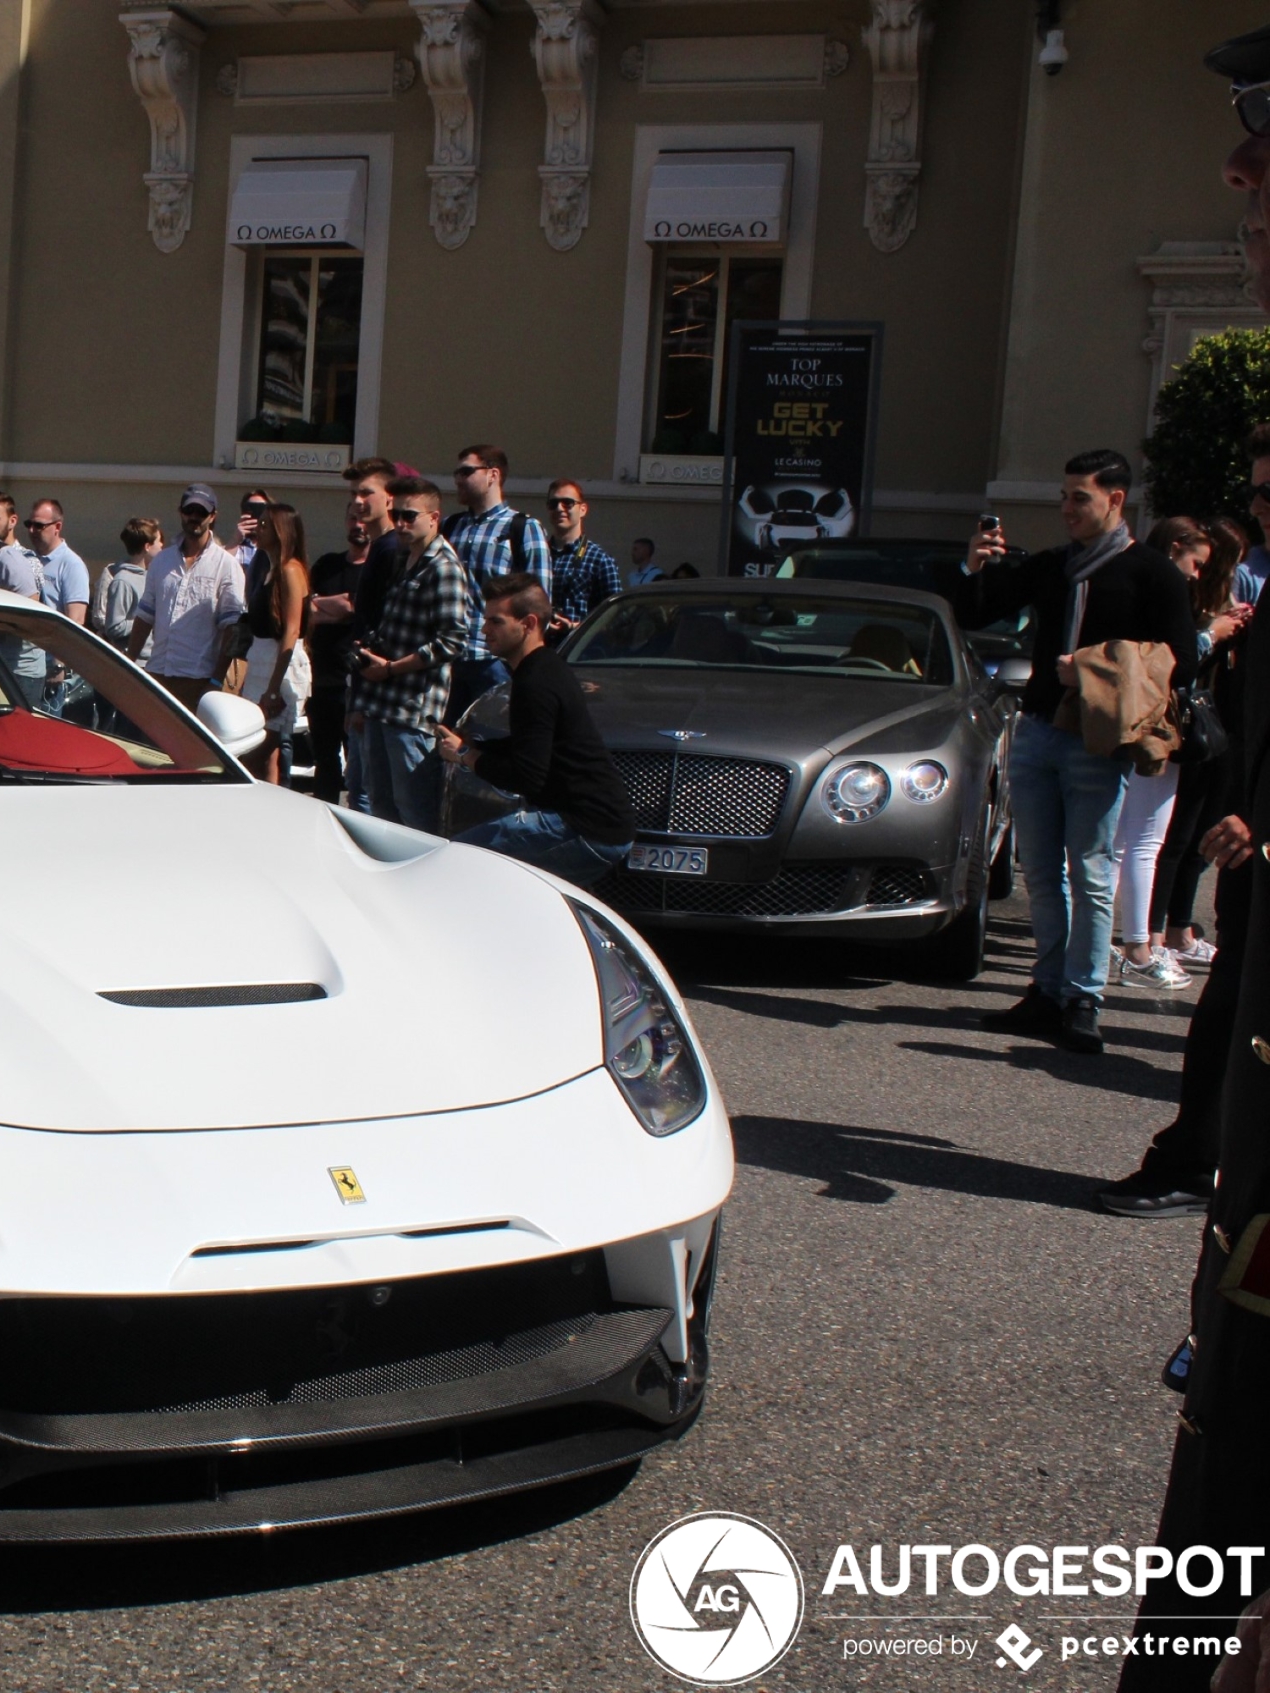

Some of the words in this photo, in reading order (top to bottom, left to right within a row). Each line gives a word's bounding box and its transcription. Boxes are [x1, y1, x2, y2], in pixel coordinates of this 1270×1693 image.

[256, 226, 316, 240] OMEGA
[676, 223, 744, 238] OMEGA
[790, 358, 821, 371] TOP
[766, 373, 843, 389] MARQUES
[773, 402, 829, 419] GET
[757, 419, 843, 436] LUCKY
[264, 451, 320, 468] OMEGA
[672, 466, 724, 480] OMEG
[648, 848, 704, 871] 2075
